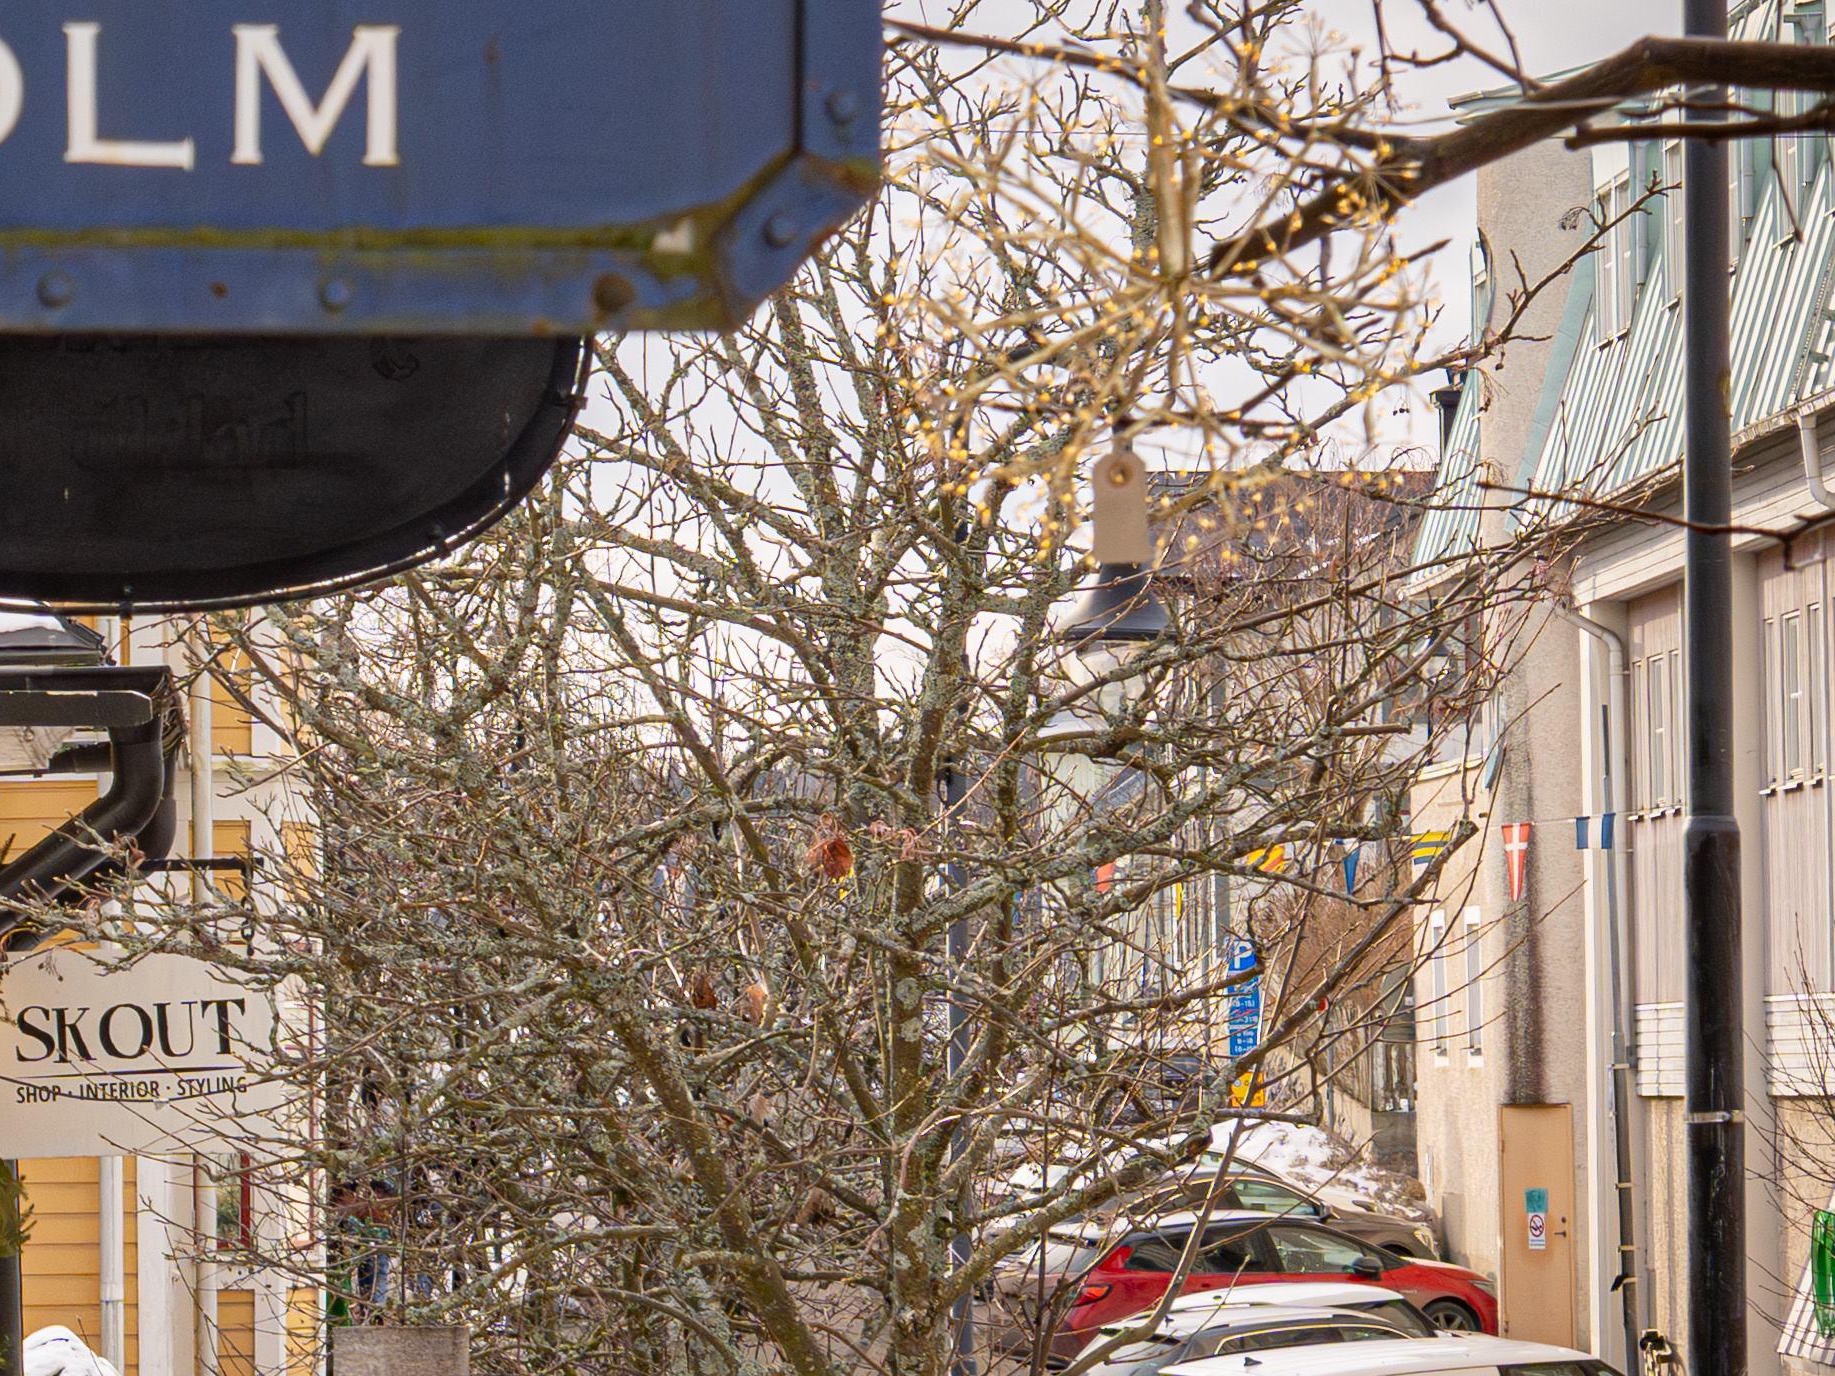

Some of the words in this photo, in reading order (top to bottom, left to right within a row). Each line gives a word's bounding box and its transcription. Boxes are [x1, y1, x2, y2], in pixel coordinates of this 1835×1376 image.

[15, 998, 246, 1064] SKOUT
[16, 1085, 62, 1104] SHOP
[79, 1079, 160, 1101] INTERIOR
[177, 1075, 248, 1096] STYLING
